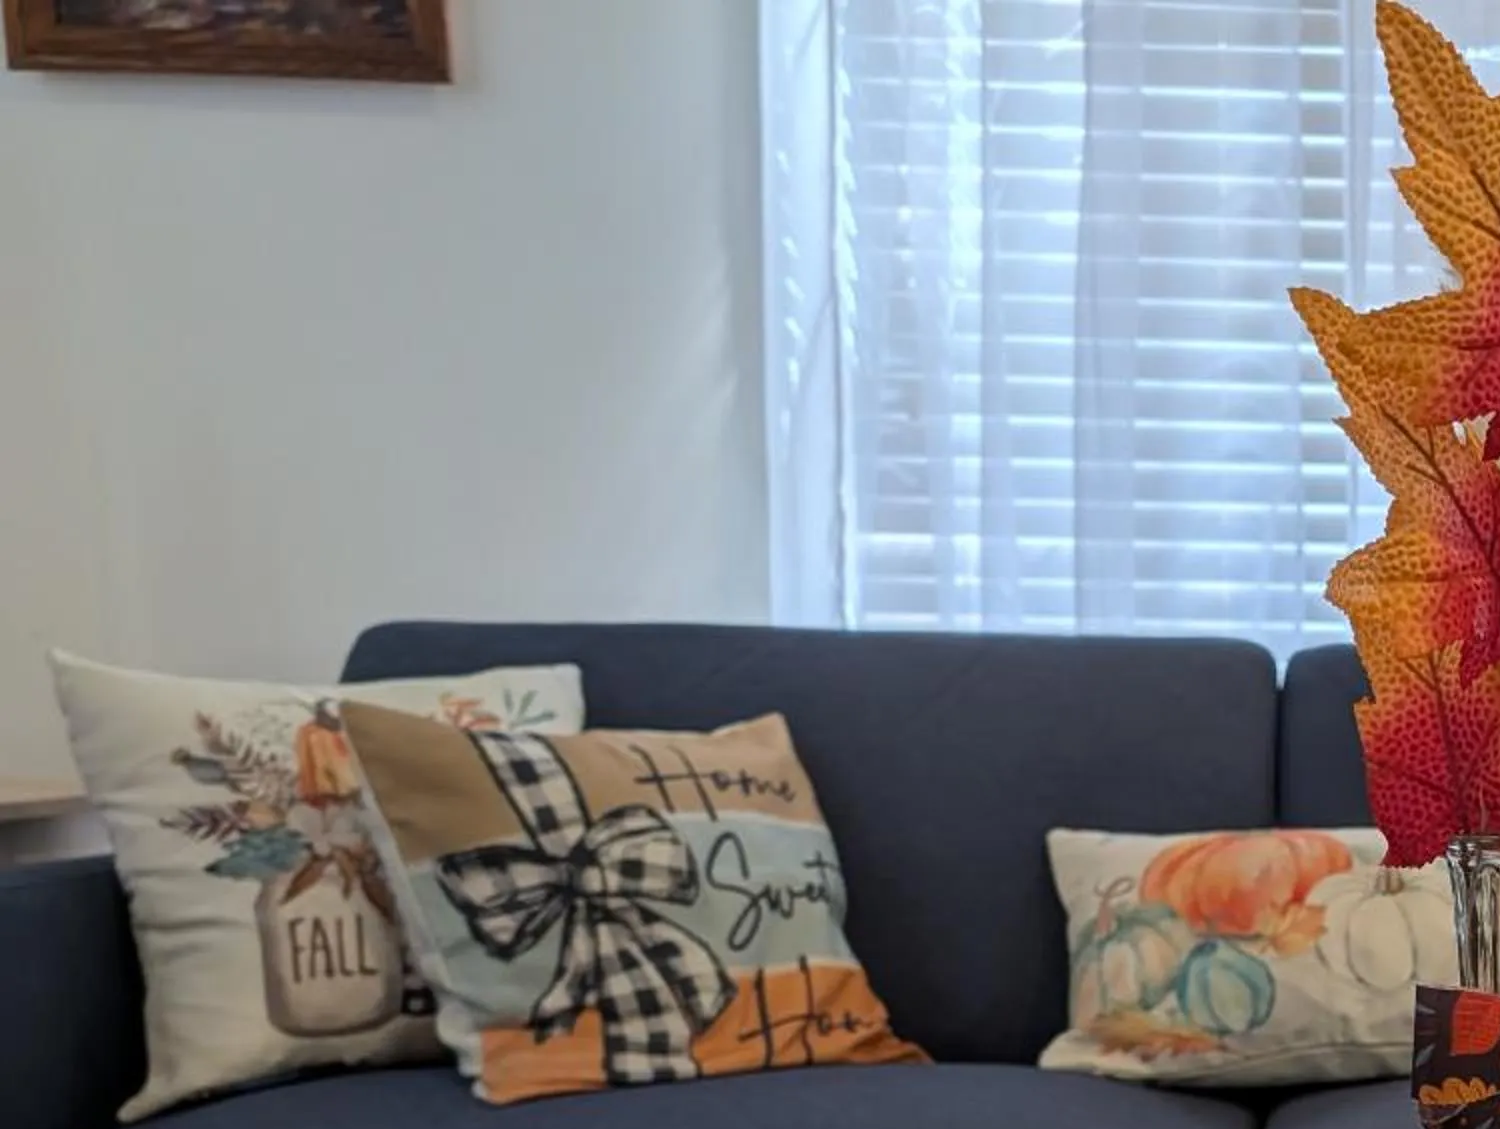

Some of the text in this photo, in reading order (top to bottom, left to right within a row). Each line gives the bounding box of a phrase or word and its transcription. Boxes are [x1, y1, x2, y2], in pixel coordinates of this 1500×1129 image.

[627, 744, 797, 822] Home
[706, 831, 840, 951] Sweet
[288, 912, 380, 984] FALL
